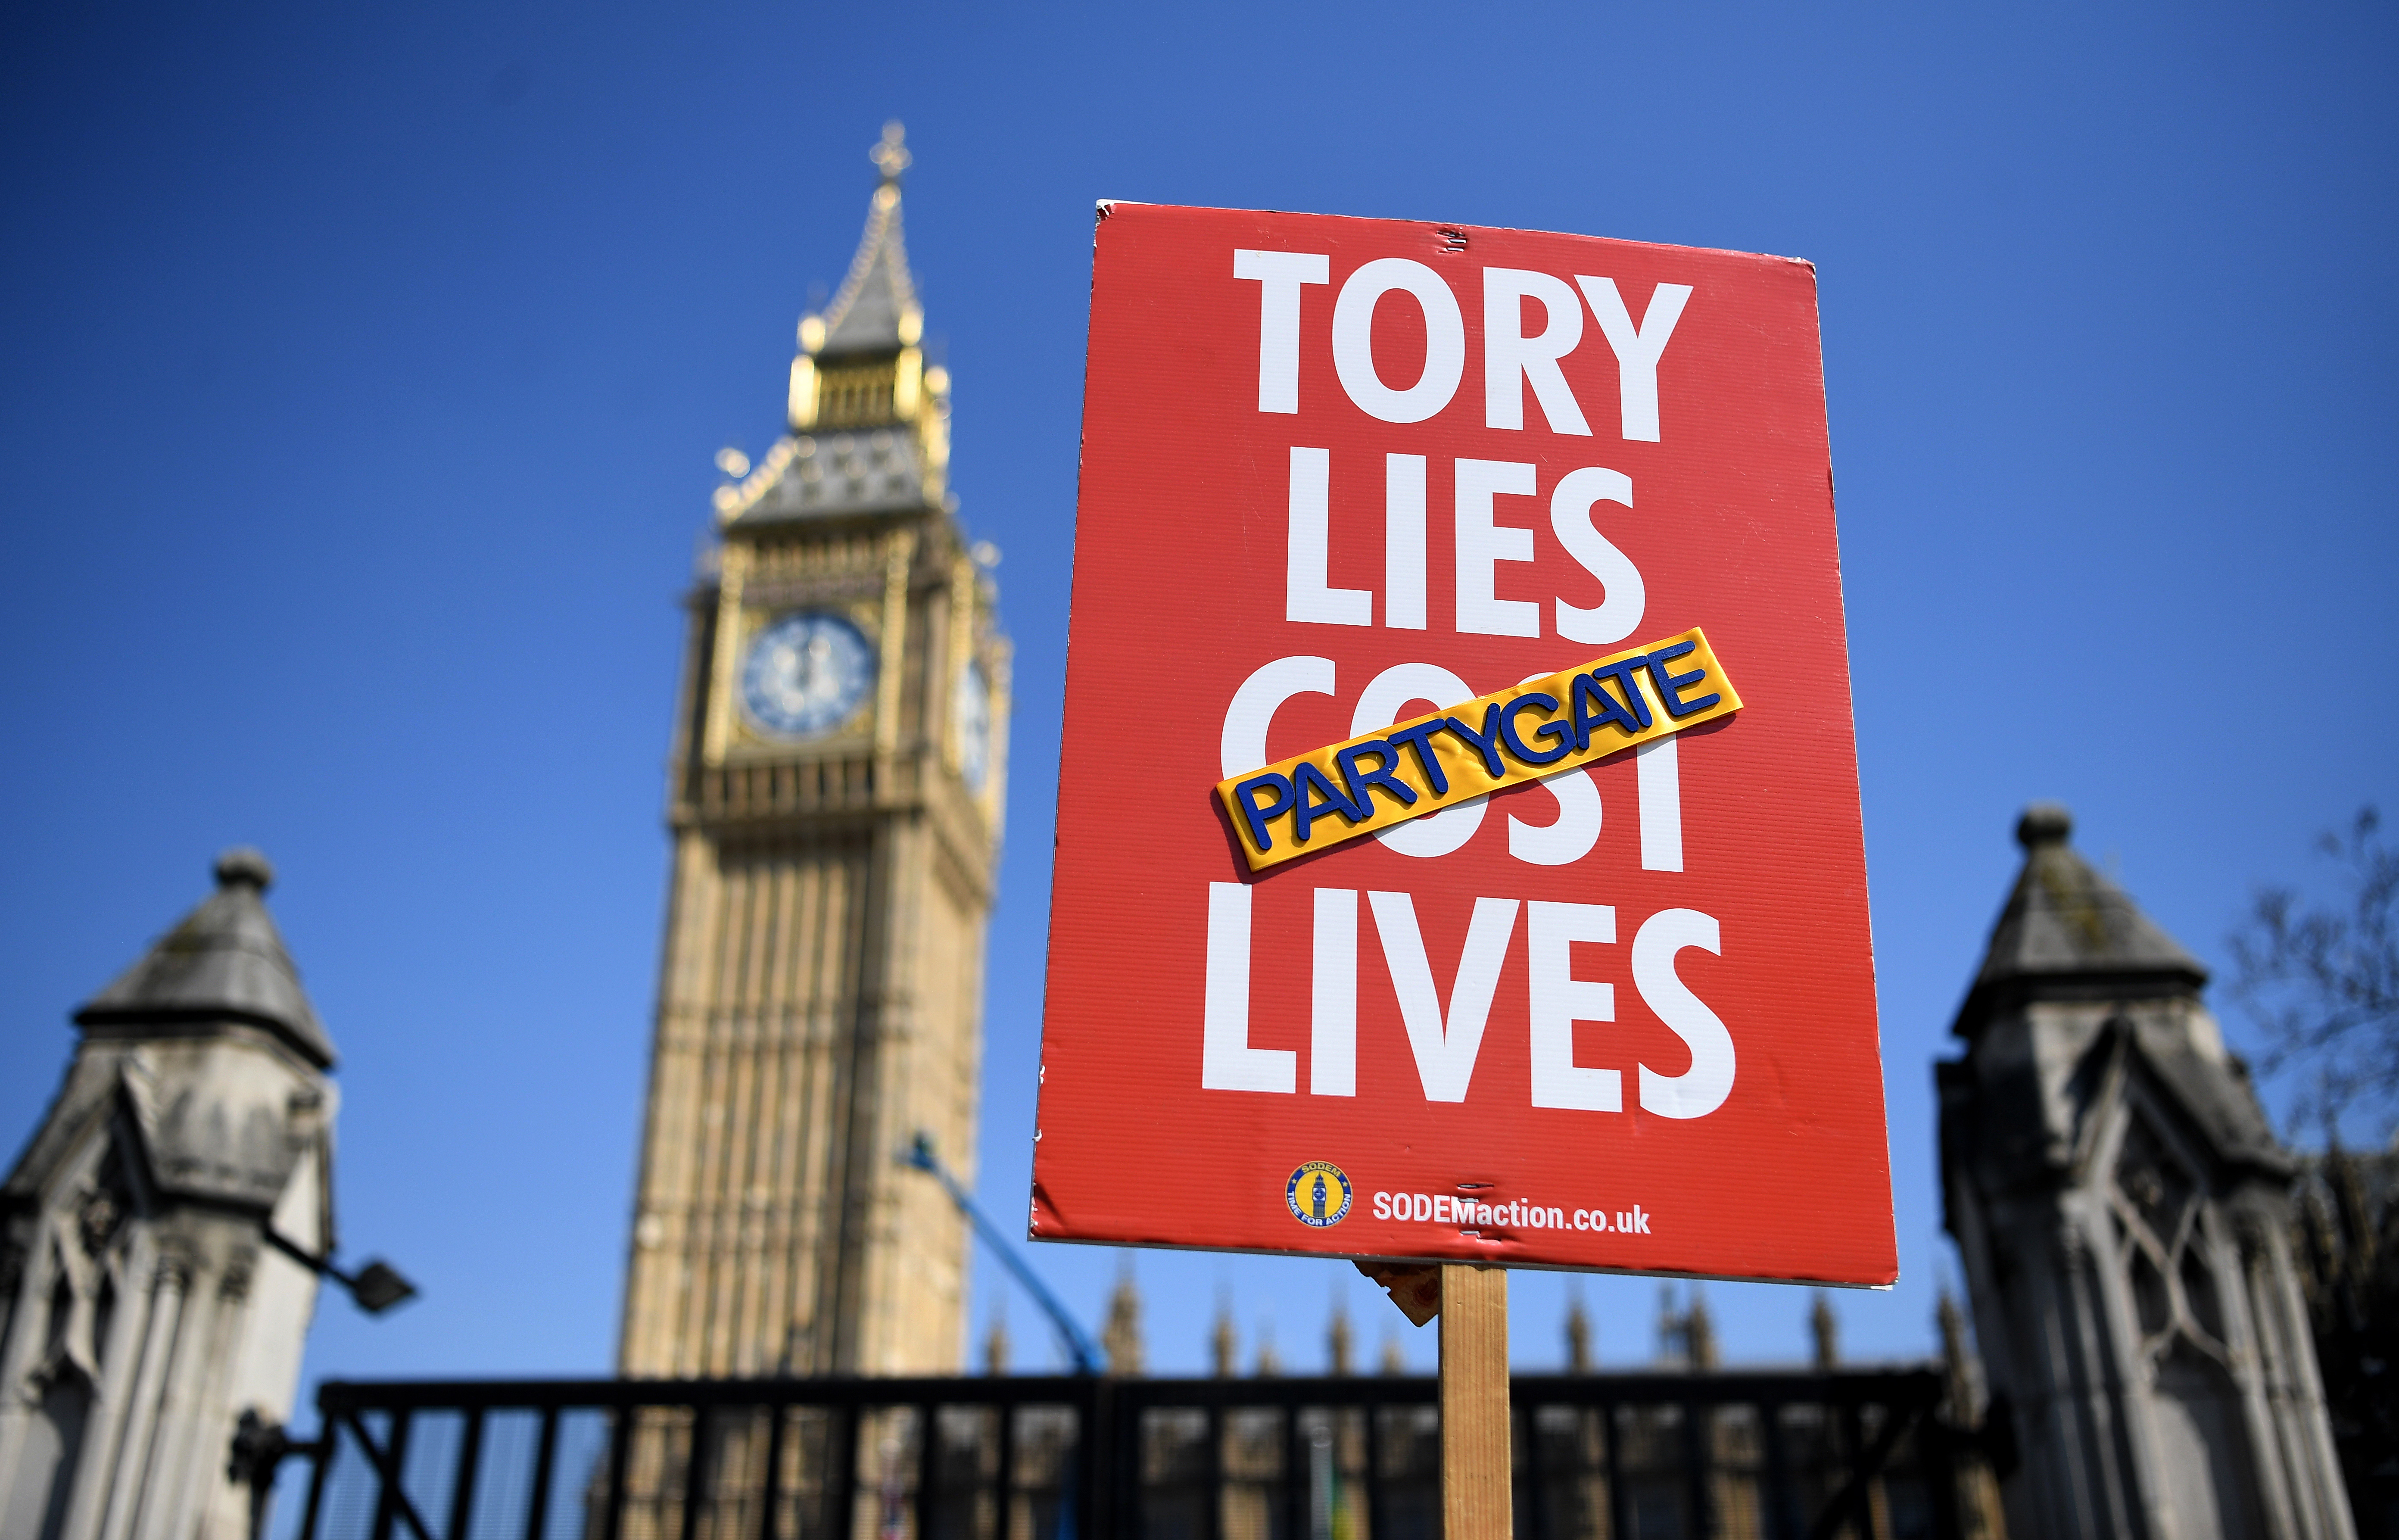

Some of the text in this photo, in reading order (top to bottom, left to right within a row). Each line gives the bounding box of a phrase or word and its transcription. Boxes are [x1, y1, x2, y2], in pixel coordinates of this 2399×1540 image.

[1233, 249, 1694, 443] TORY
[1286, 446, 1646, 645] LIES
[1236, 640, 1721, 850] PARTYGATE
[1201, 881, 1736, 1120] LIVES
[1287, 1191, 1351, 1226] TIME FOR ACTION
[1302, 1163, 1342, 1177] SODEM
[1372, 1191, 1651, 1234] SODEMaction.co.uk
